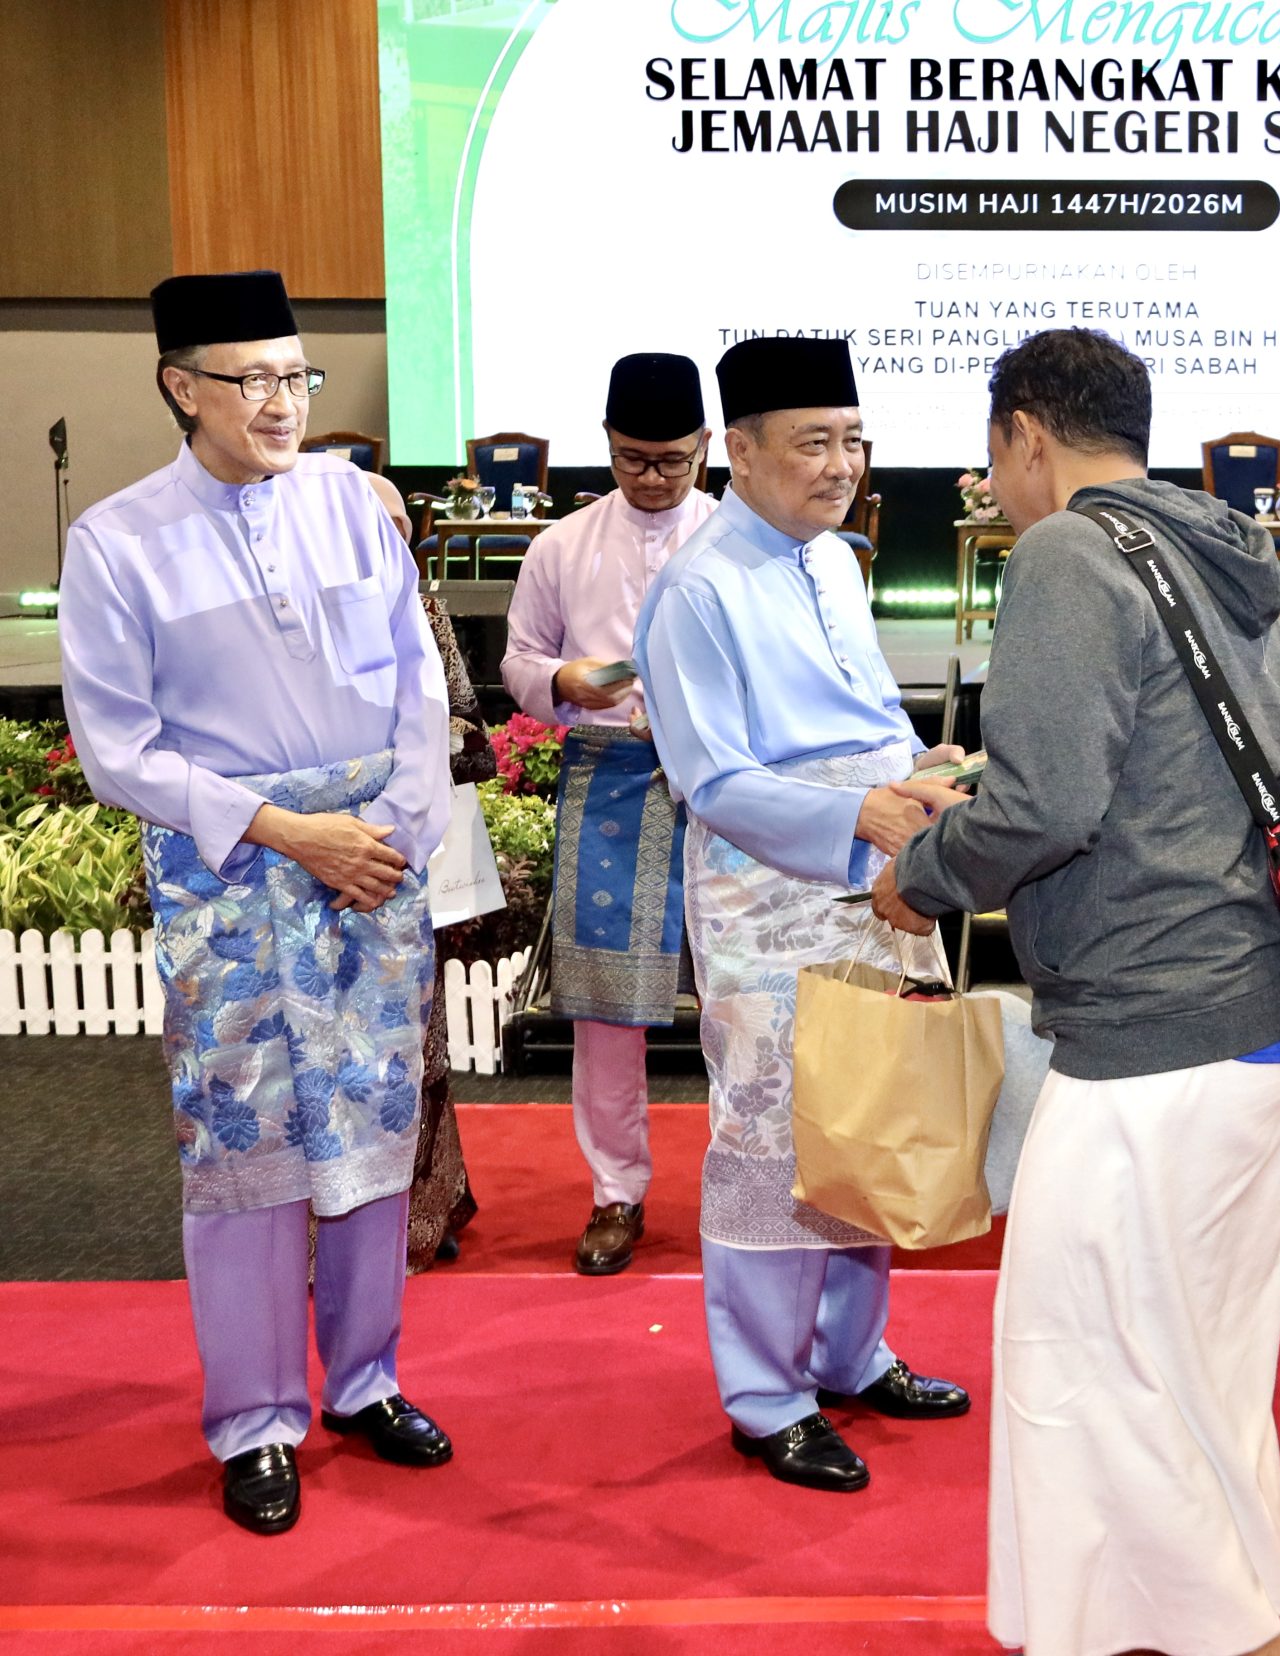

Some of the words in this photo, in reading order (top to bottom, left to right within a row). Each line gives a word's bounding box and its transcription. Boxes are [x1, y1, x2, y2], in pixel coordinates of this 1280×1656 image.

[671, 0, 920, 68] Majlis
[646, 57, 886, 101] SELAMAT
[910, 58, 1233, 102] BERANGKAT
[672, 109, 879, 153] JEMAAH
[907, 110, 1017, 153] HAJI
[1045, 111, 1238, 153] NEGERI
[875, 193, 967, 214] MUSIM
[979, 193, 1038, 214] HAJI
[1051, 193, 1243, 215] 1447H/2026M
[917, 263, 1125, 281] DISEMPURNAKAN
[1135, 263, 1197, 281] OLEH
[915, 301, 978, 318] TUAN
[989, 301, 1056, 318] YANG
[1066, 301, 1199, 318] TERUTAMA
[868, 328, 922, 346] SERI
[1135, 330, 1203, 347] MUSA
[1214, 330, 1252, 347] BIN
[857, 357, 924, 374] YANG
[1174, 357, 1257, 374] SABAH
[1184, 629, 1201, 653] BANK
[1194, 650, 1211, 679] ISLAM
[1217, 701, 1234, 727] BANK
[1227, 722, 1246, 751] ISLAM
[1251, 772, 1267, 798] BANK
[1261, 793, 1280, 822] ISLAM
